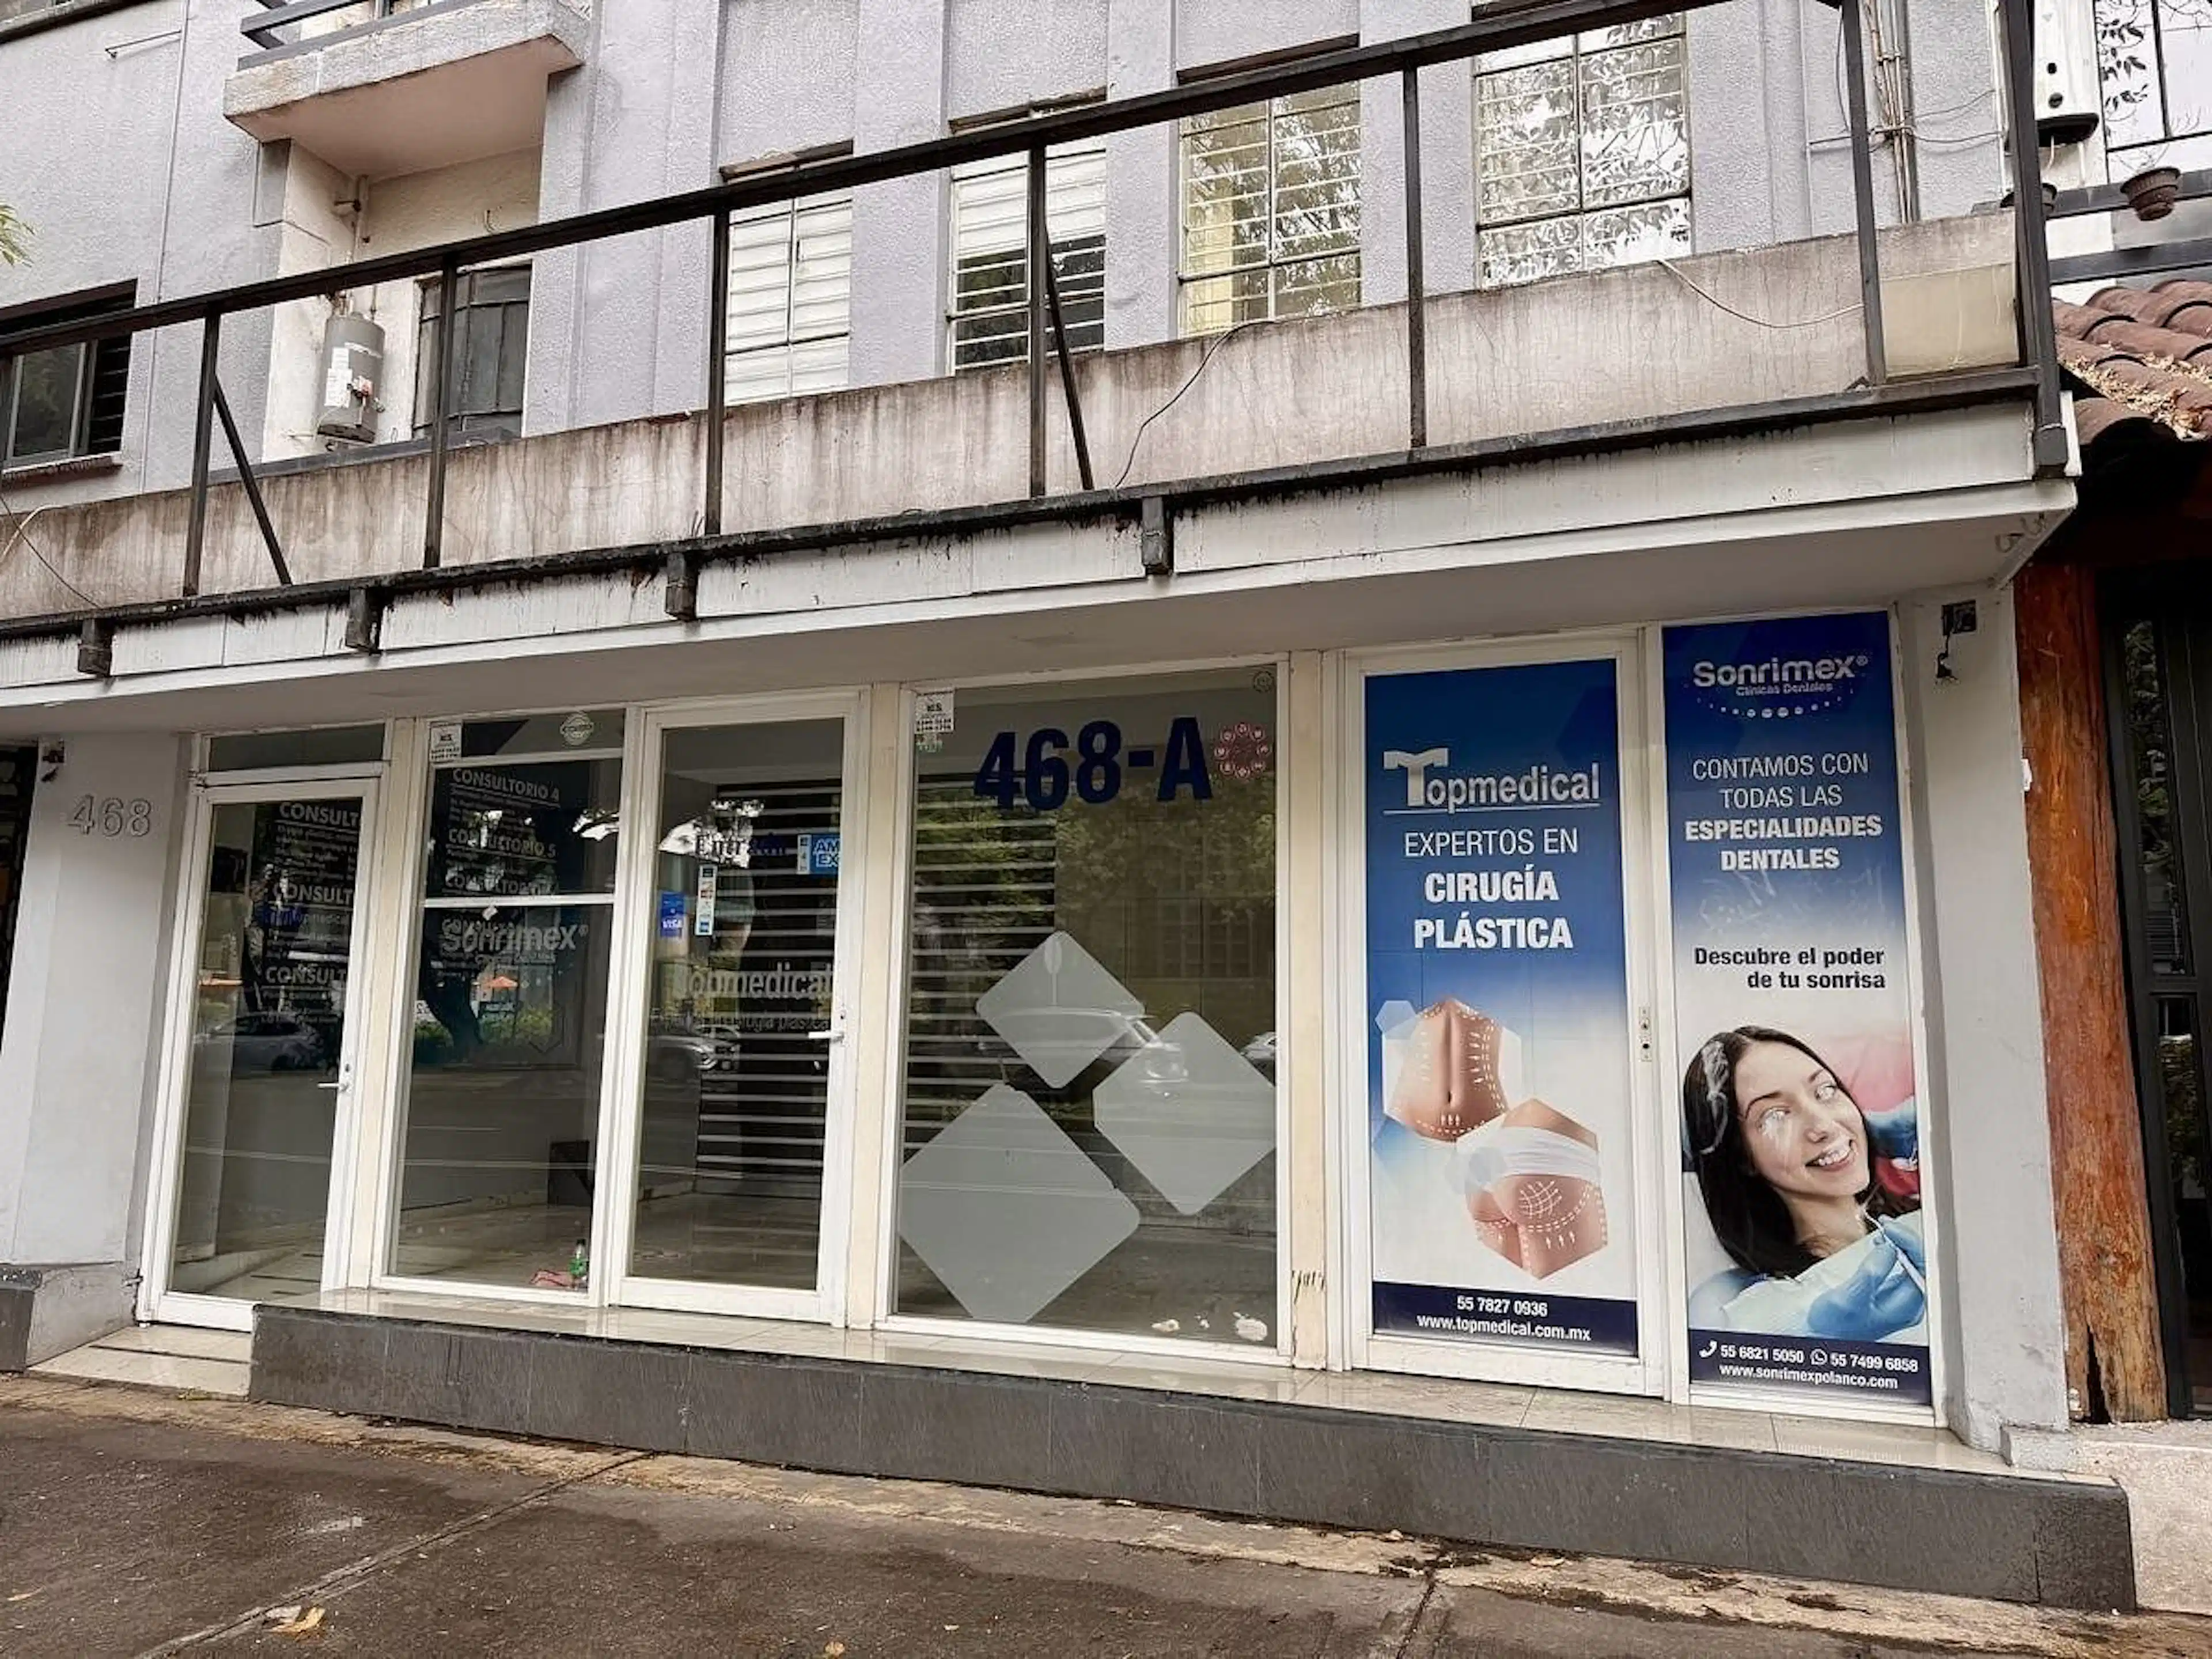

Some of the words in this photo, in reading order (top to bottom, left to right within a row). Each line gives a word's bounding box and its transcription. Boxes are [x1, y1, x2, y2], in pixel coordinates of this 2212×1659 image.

[974, 717, 1213, 810] 468-A
[1692, 754, 1815, 781] CONTAMOS
[1821, 752, 1869, 776] CON
[452, 768, 548, 798] CONSULTORIO
[1383, 748, 1600, 814] Topmedical
[1718, 785, 1793, 809] TODAS
[1801, 783, 1843, 806] LAS
[66, 793, 151, 837] 468
[279, 801, 359, 827] CONSULT
[1685, 816, 1883, 841] ESPECIALIDADES
[1404, 830, 1535, 857] EXPERTOS
[1544, 828, 1578, 854] EN
[1720, 847, 1840, 872] DENTALES
[1425, 864, 1560, 904] CIRUGÍA
[1414, 912, 1574, 949] PLÁSTICA
[1694, 948, 1791, 965] Descubre
[1797, 948, 1816, 965] el
[1823, 948, 1884, 968] poder
[1747, 972, 1772, 988] de
[1779, 972, 1800, 988] tu
[1806, 972, 1886, 989] sonrisa
[1456, 1296, 1474, 1311] 55
[1477, 1297, 1510, 1314] 7827
[1514, 1300, 1548, 1317] 0936
[1416, 1315, 1592, 1342] www.topmedical.com.mx
[1720, 1344, 1736, 1358] 55
[1738, 1346, 1769, 1361] 6821
[1772, 1348, 1804, 1364] 5050
[1830, 1353, 1847, 1367] 55
[1850, 1354, 1883, 1370] 7499
[1719, 1364, 1899, 1390] www.sonrimexpolanco.com
